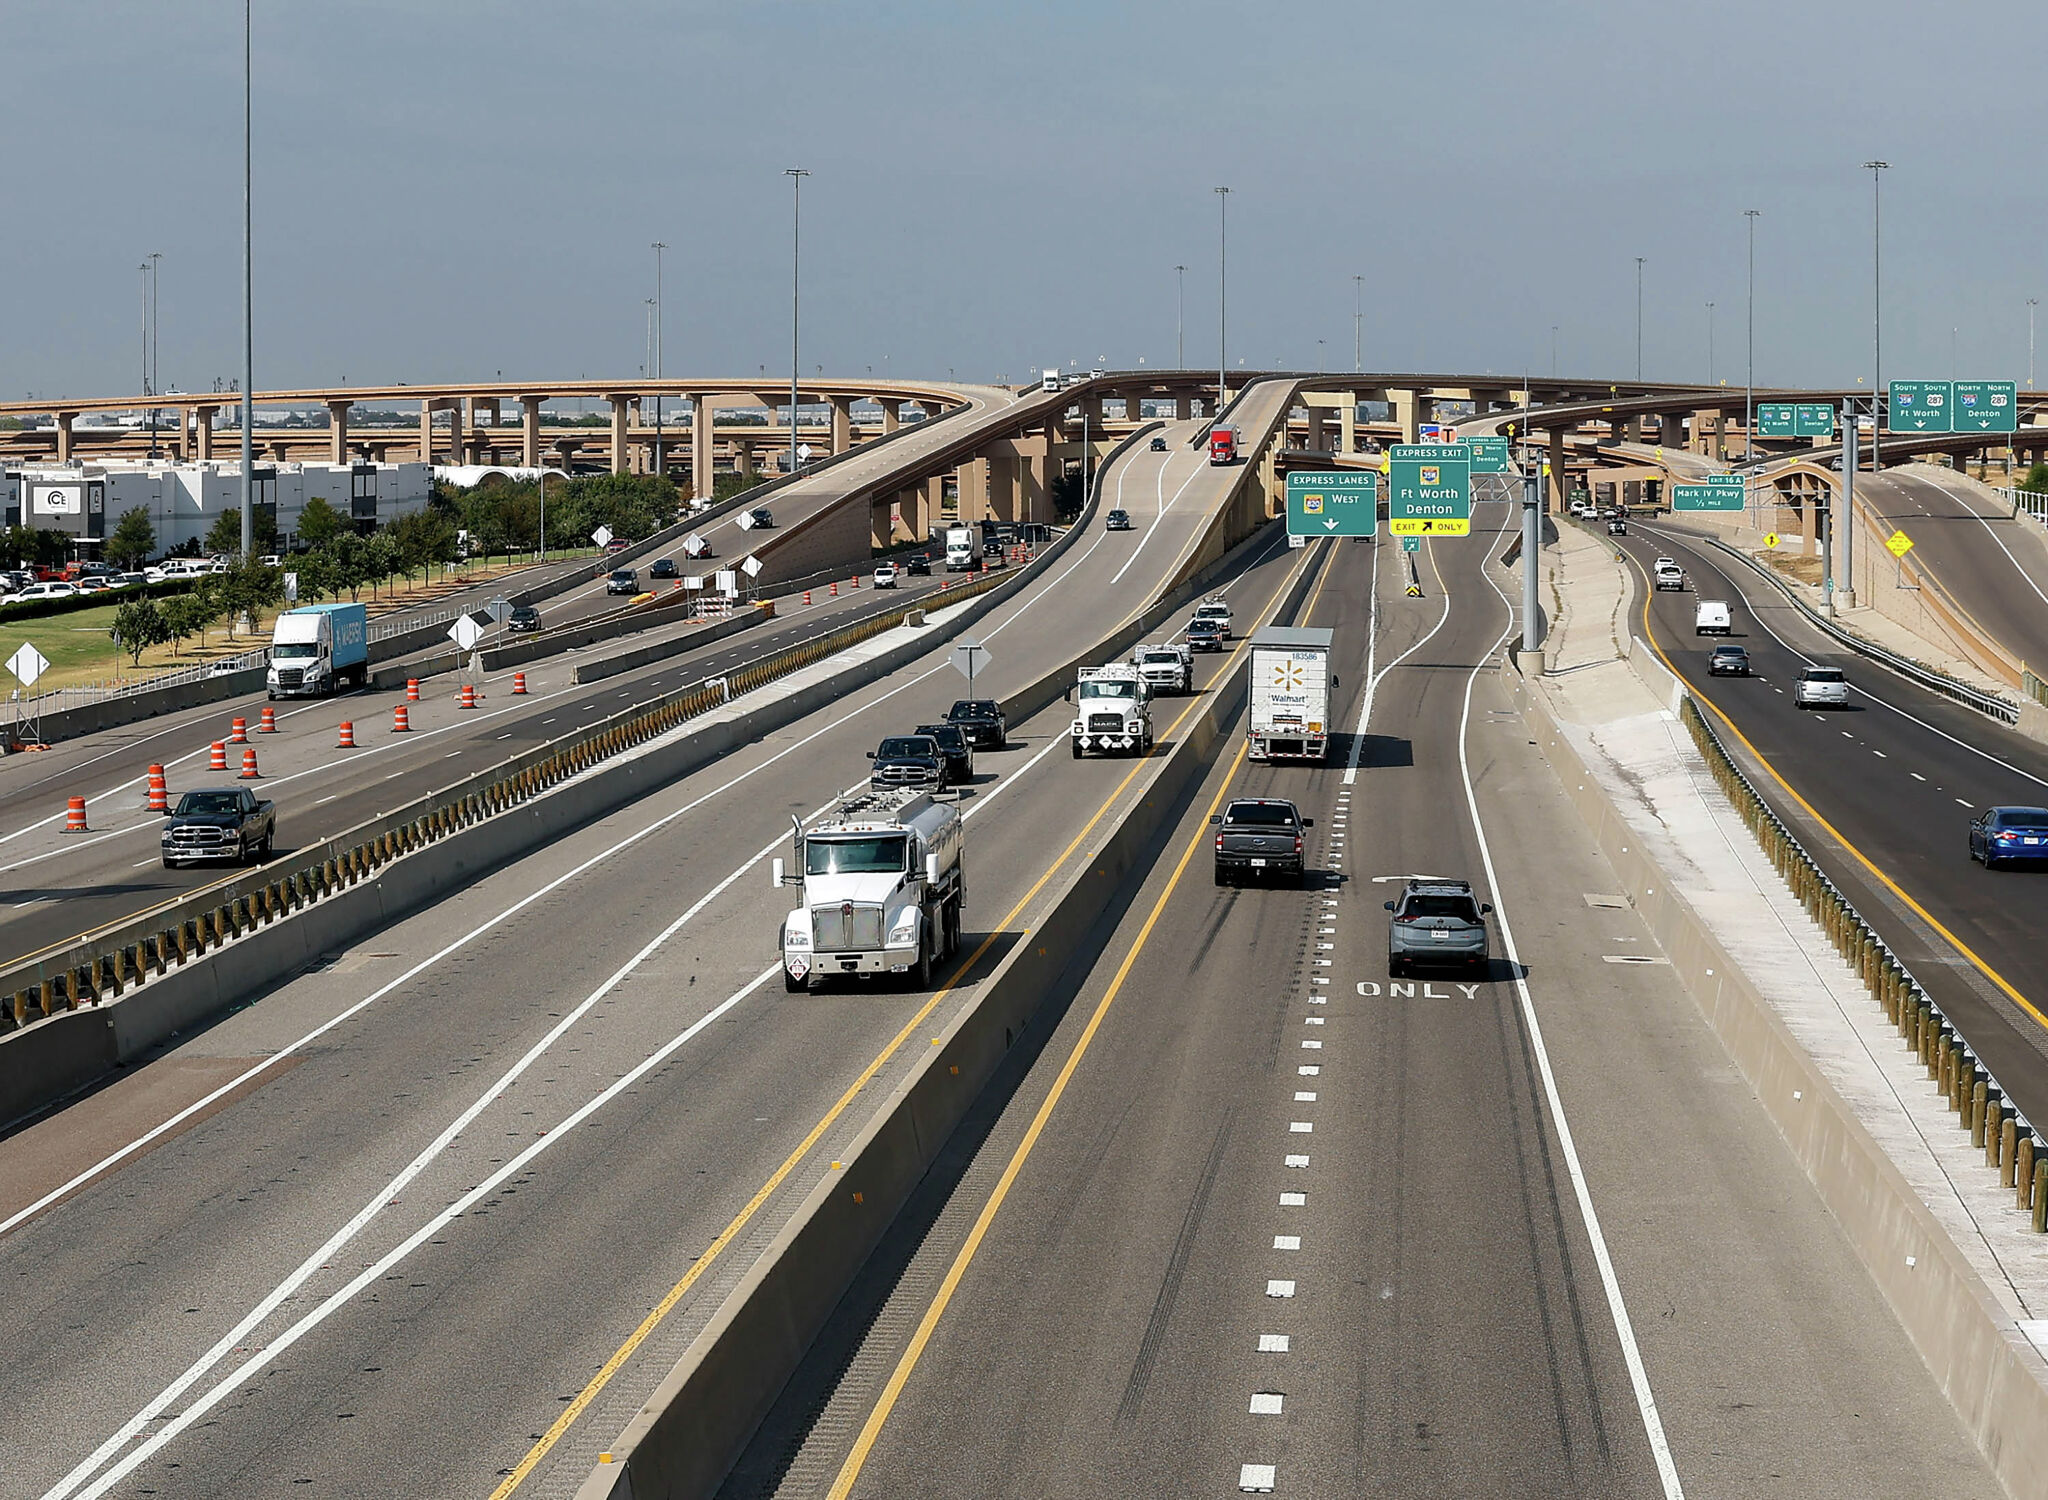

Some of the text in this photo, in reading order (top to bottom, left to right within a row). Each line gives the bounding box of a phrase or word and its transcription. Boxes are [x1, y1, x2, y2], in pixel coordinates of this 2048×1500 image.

[1900, 409, 1940, 417] Ft Worth
[1968, 409, 2000, 417] Denton
[1396, 449, 1463, 457] EXPRESS EXIT
[1293, 476, 1369, 485] EXPRESS LANES
[1401, 488, 1459, 499] Ft Worth
[1677, 489, 1740, 499] Mark IV Pkwy
[1331, 494, 1360, 504] WEST
[1406, 504, 1453, 514] Denton
[1395, 523, 1463, 531] EXIT ONLY
[1292, 652, 1318, 661] 183586
[1271, 695, 1306, 703] Walmart
[1356, 981, 1480, 1000] ONLY
